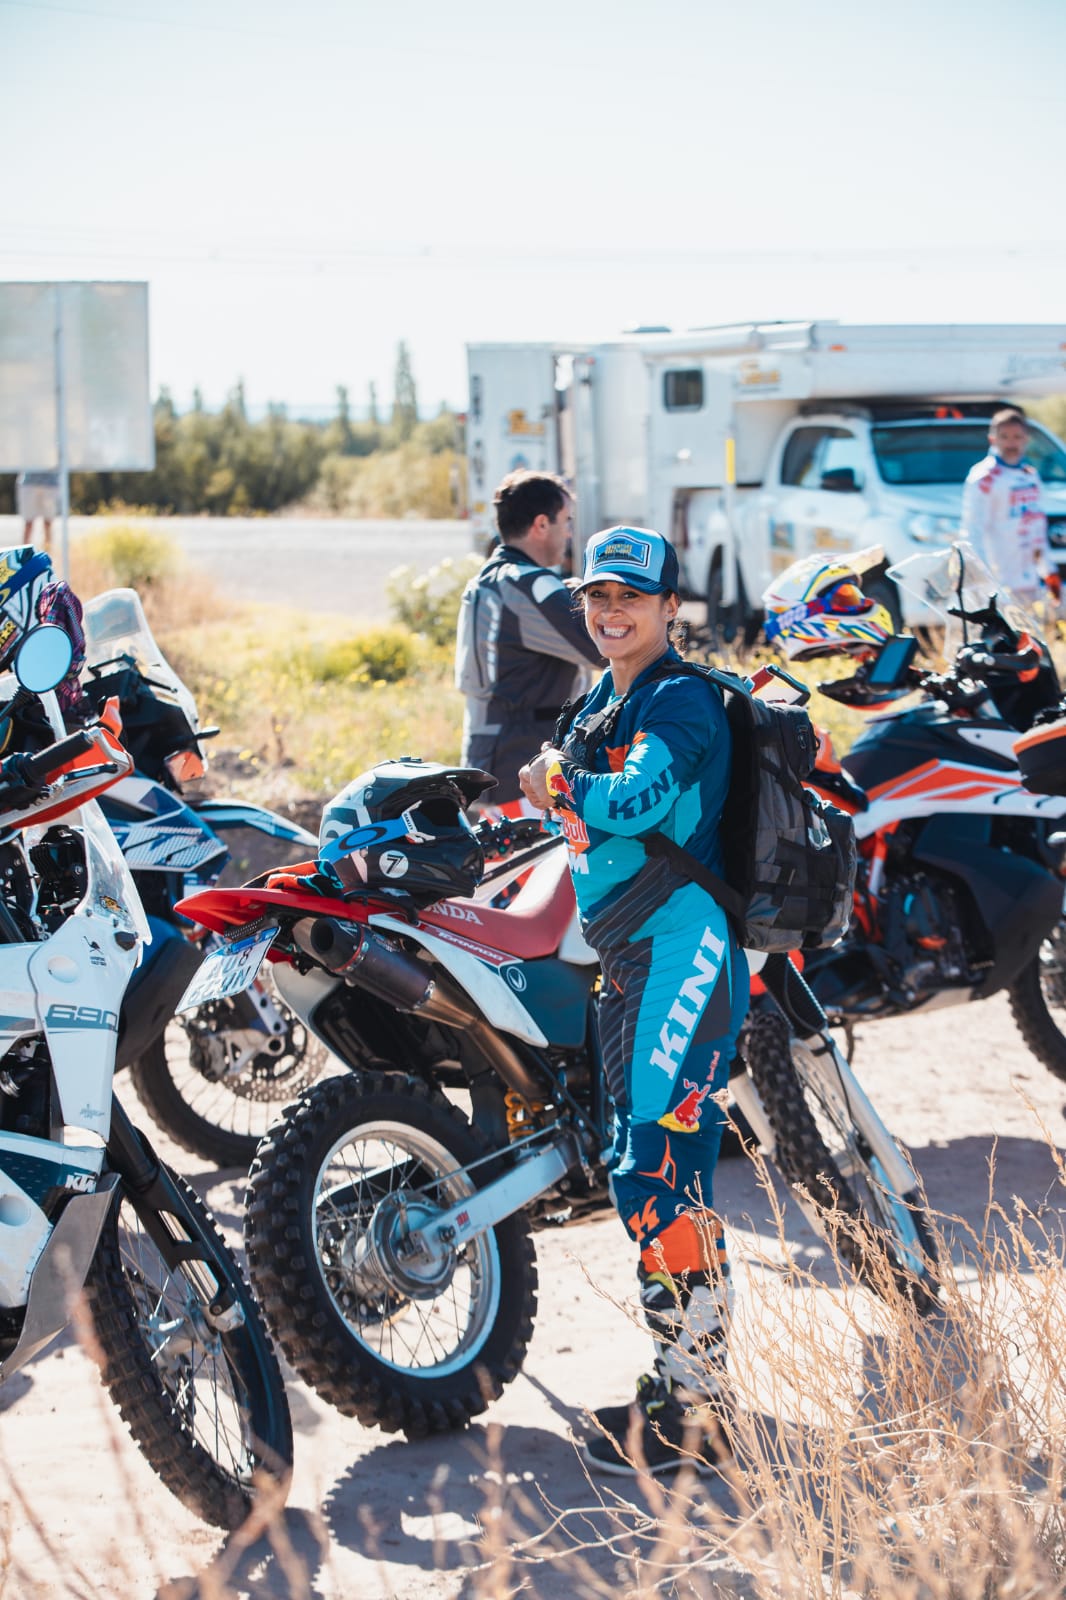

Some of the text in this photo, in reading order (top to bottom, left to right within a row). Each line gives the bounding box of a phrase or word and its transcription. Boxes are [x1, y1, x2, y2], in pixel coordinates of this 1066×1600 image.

[386, 853, 405, 874] 7
[424, 902, 484, 926] NDA
[650, 926, 725, 1080] KINI
[46, 1004, 118, 1030] 690
[65, 1171, 97, 1195] KTM
